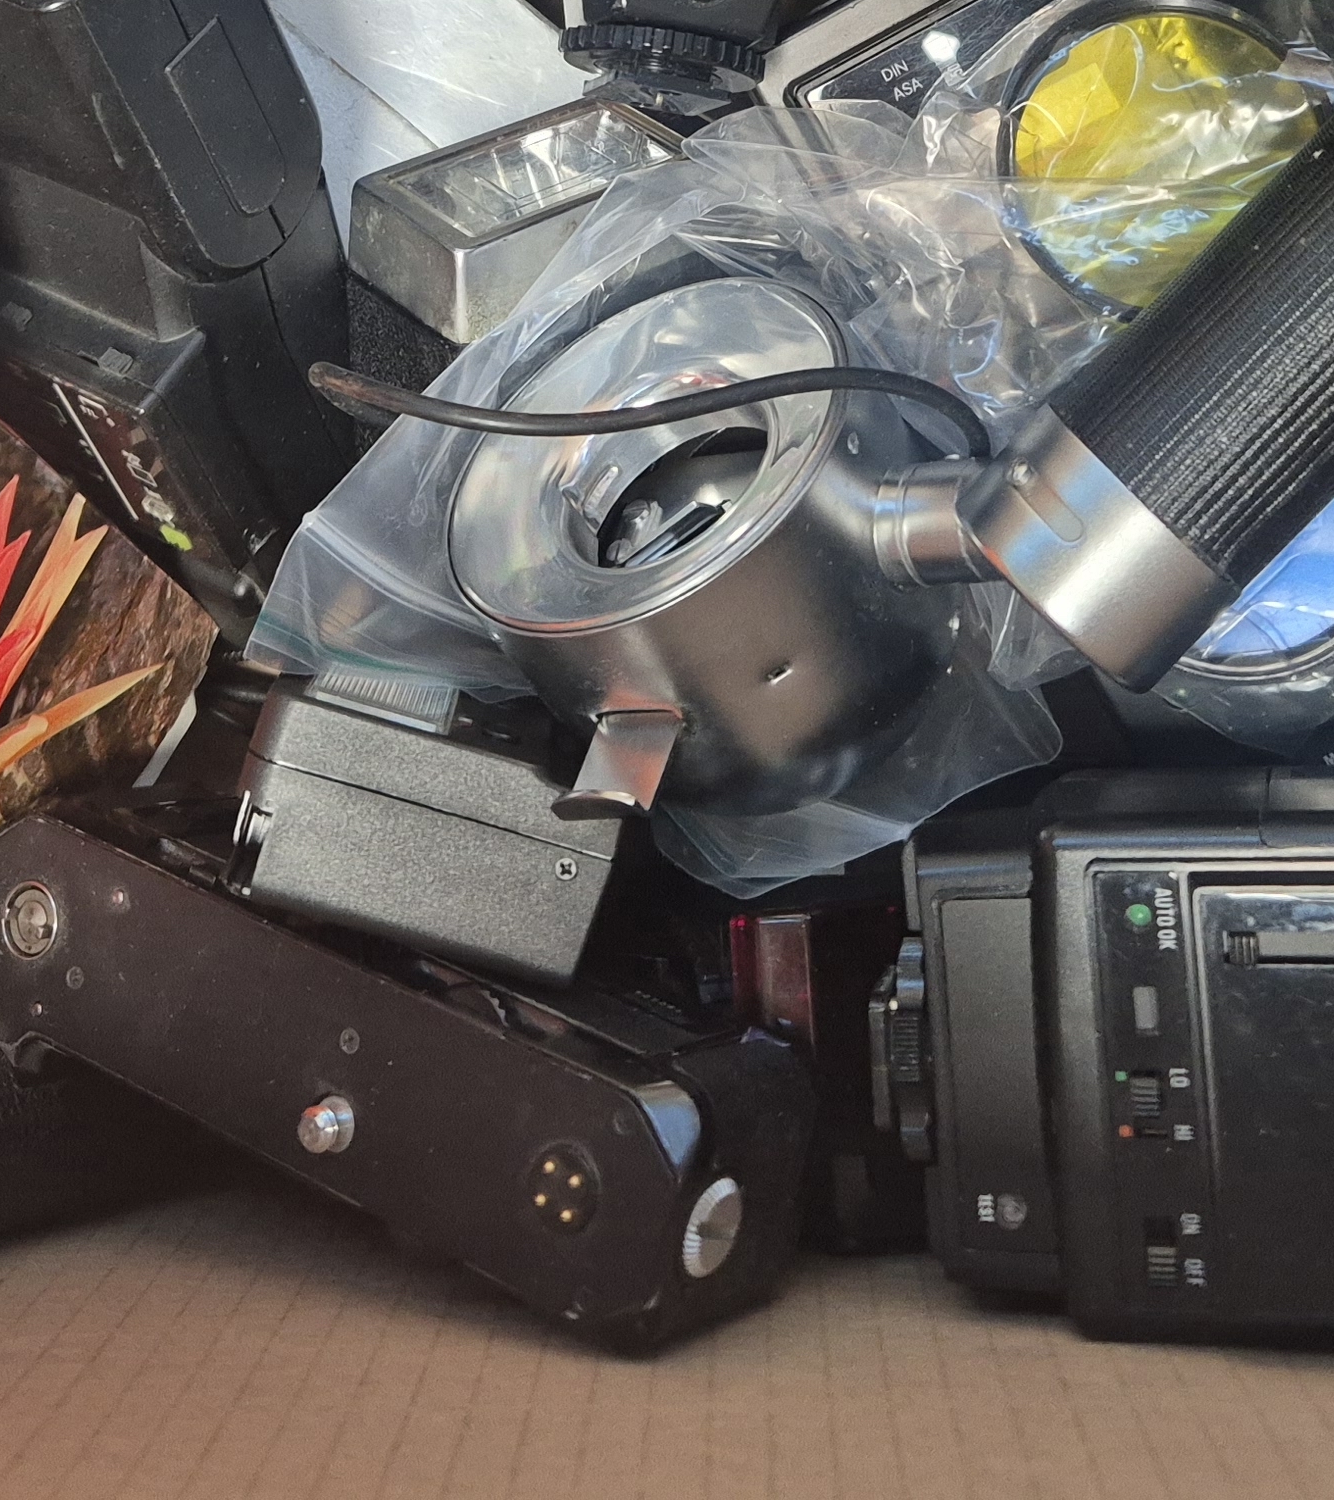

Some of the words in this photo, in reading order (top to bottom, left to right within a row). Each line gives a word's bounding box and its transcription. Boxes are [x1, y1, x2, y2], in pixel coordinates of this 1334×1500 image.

[880, 60, 909, 82] DIN
[893, 77, 924, 102] ASA
[1155, 887, 1176, 928] AUTO
[1157, 929, 1178, 950] OK
[1169, 1067, 1191, 1088] LO
[1180, 1212, 1202, 1235] ON
[1184, 1258, 1207, 1288] OFF
